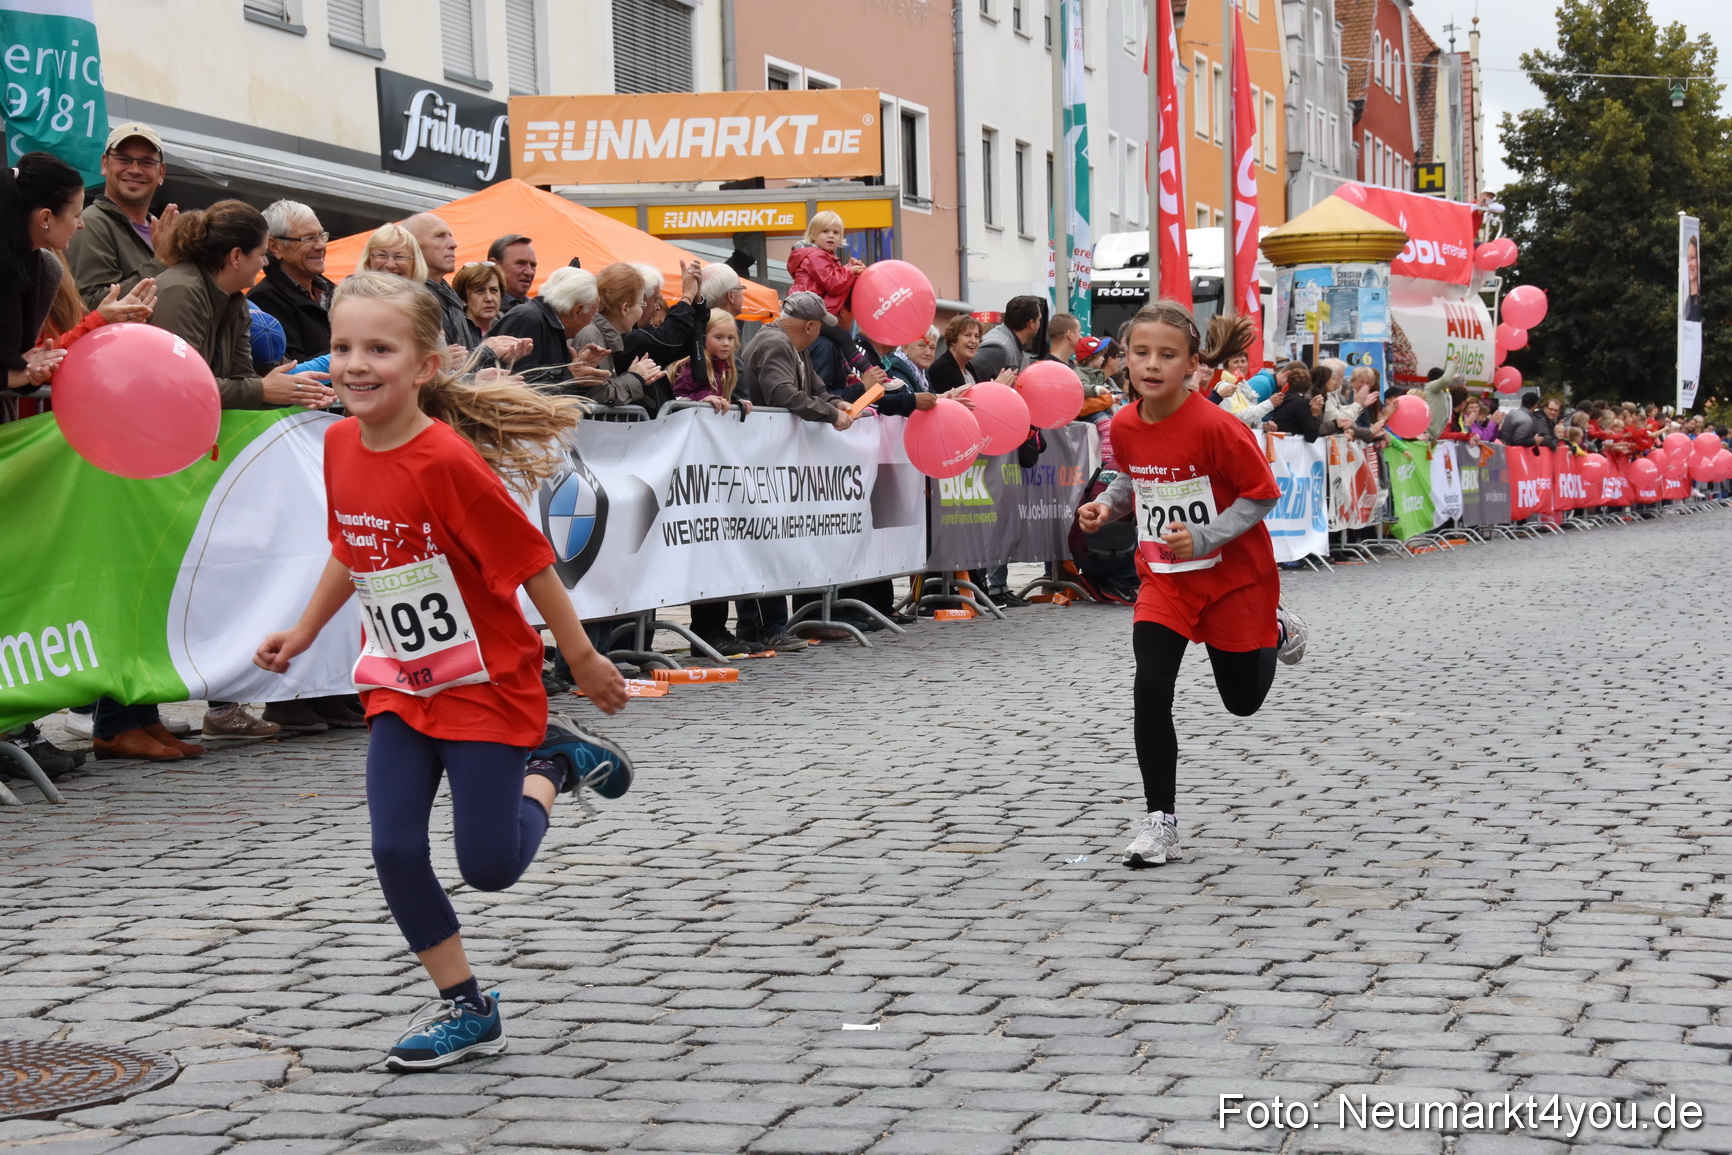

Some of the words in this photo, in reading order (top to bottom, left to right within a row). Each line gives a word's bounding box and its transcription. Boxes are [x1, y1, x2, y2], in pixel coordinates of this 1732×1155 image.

[7, 82, 96, 138] 9181
[393, 89, 508, 182] frühauf
[523, 114, 862, 162] RUNMARKT.DE
[1418, 166, 1443, 189] H
[663, 208, 794, 229] RUNMARKT.DE
[1097, 281, 1145, 297] RÖDL
[872, 286, 911, 320] RÖDL
[1443, 303, 1484, 341] AVIA
[1157, 481, 1203, 498] BOCK
[805, 512, 863, 537] FAHRFREUDE.
[1159, 546, 1177, 562] Sop
[370, 564, 439, 593] BOCK
[463, 630, 471, 640] K
[0, 620, 99, 690] men
